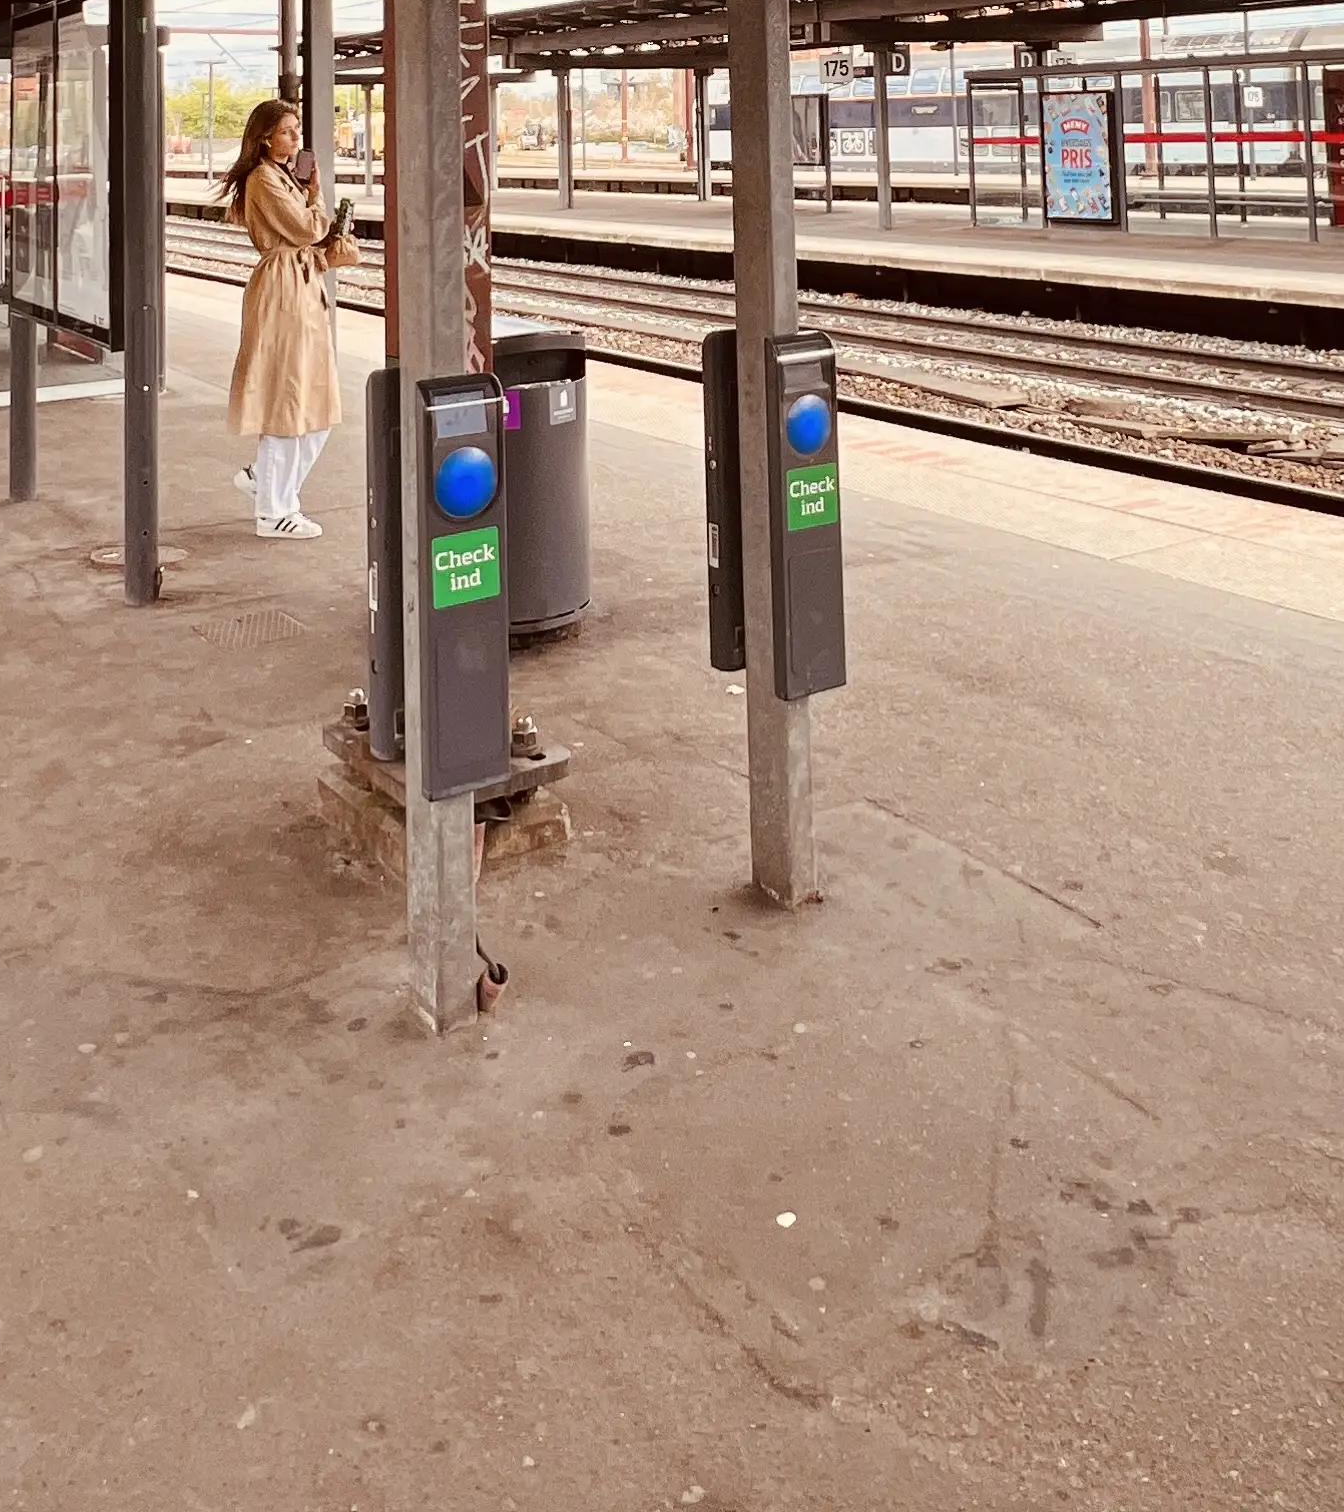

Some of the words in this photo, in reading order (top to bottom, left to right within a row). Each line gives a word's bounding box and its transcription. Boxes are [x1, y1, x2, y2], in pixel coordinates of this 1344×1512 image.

[823, 60, 850, 77] 175
[891, 52, 906, 73] D
[1062, 120, 1089, 131] MENY
[1061, 149, 1093, 169] PRIS
[789, 475, 835, 498] Check
[800, 496, 825, 516] ind
[435, 543, 496, 571] Check
[450, 567, 482, 593] ind
